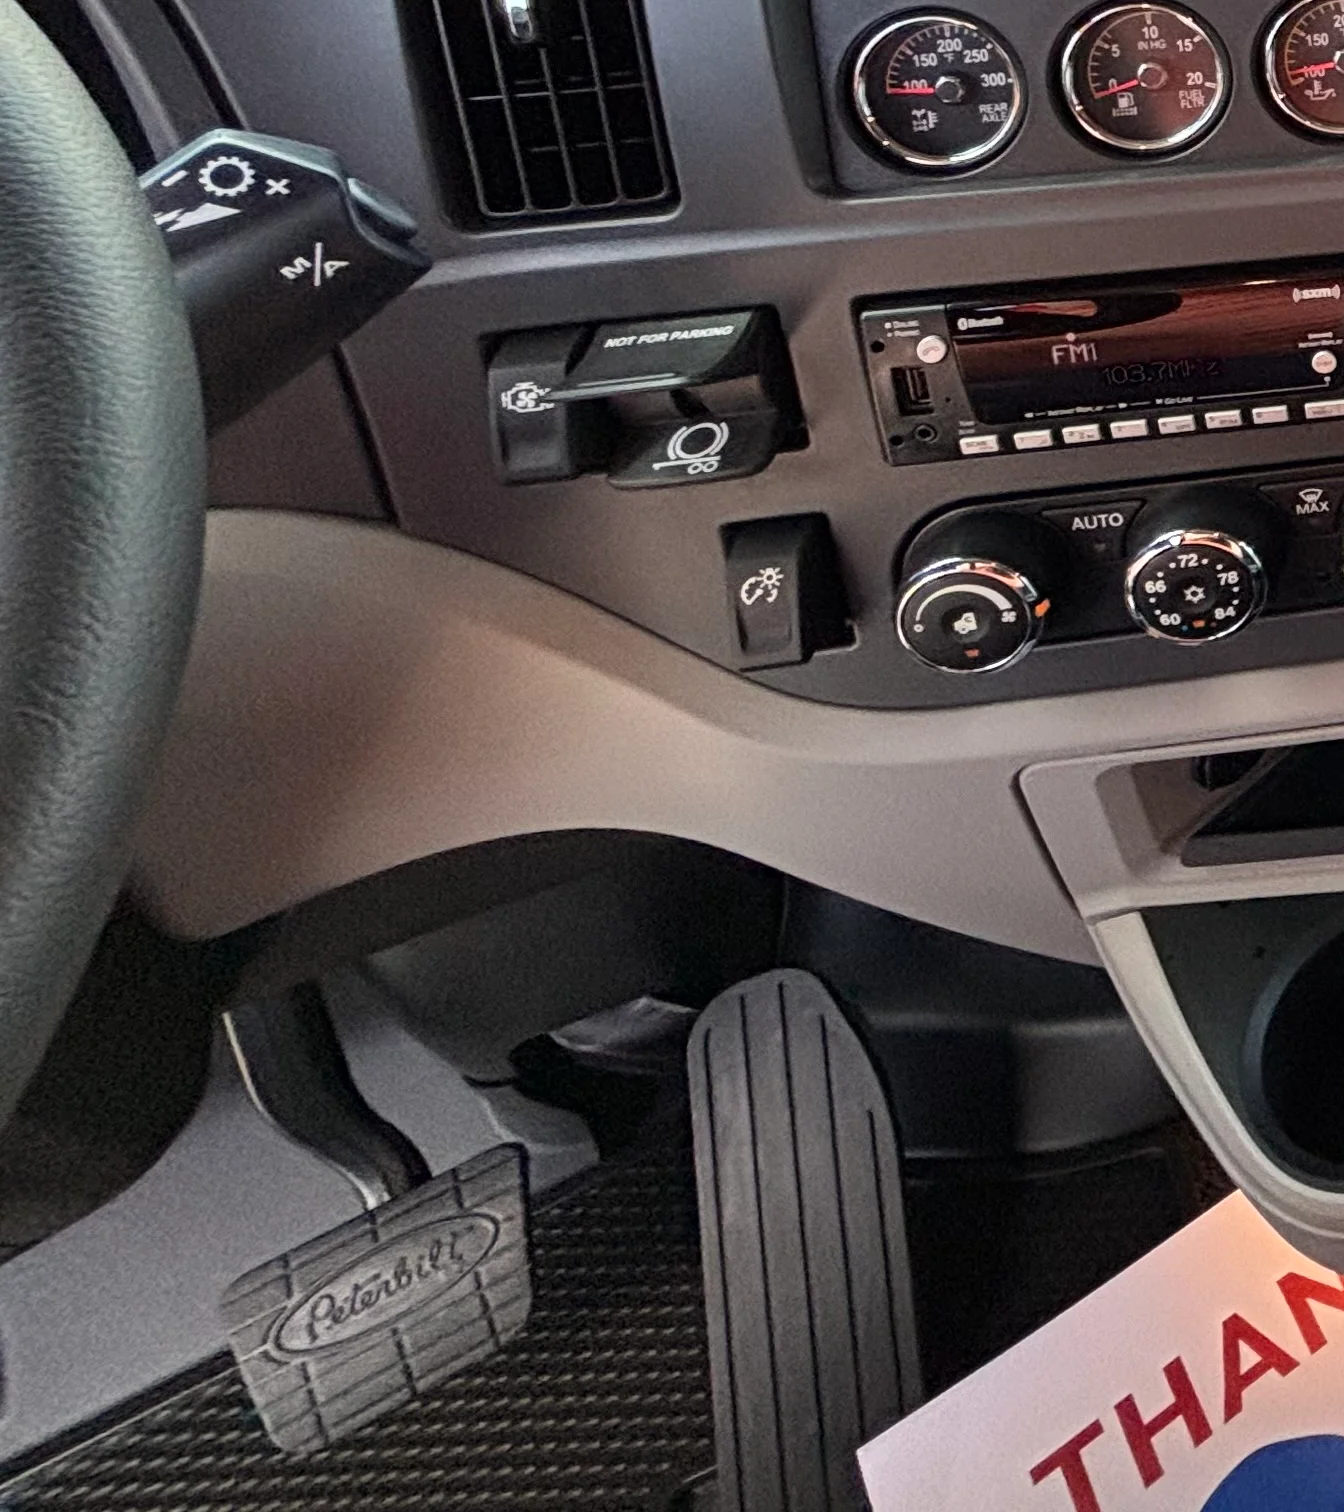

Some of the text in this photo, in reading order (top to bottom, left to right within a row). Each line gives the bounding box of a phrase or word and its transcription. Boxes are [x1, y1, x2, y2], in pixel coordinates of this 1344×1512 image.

[1141, 26, 1158, 39] 10
[937, 38, 962, 53] 200
[1137, 39, 1167, 50] IN HG
[1176, 39, 1193, 52] 15
[1305, 33, 1329, 47] 150
[963, 49, 989, 64] 250
[1112, 44, 1120, 57] 5
[912, 53, 938, 67] 150
[980, 72, 1006, 87] 300
[1186, 72, 1203, 85] 20
[1179, 90, 1205, 100] FUEL
[979, 102, 1008, 114] REAR
[981, 111, 1008, 123] AXLE
[604, 325, 735, 348] NOT FOR PARKING
[1051, 342, 1099, 366] FM1
[1296, 500, 1330, 516] MAX
[1071, 512, 1124, 532] AUTO
[1177, 553, 1199, 568] 72
[1217, 570, 1239, 585] 78
[1145, 580, 1167, 594] 66
[1160, 612, 1182, 626] 60
[1214, 606, 1236, 621] 84
[307, 1224, 477, 1345] Peterbilt
